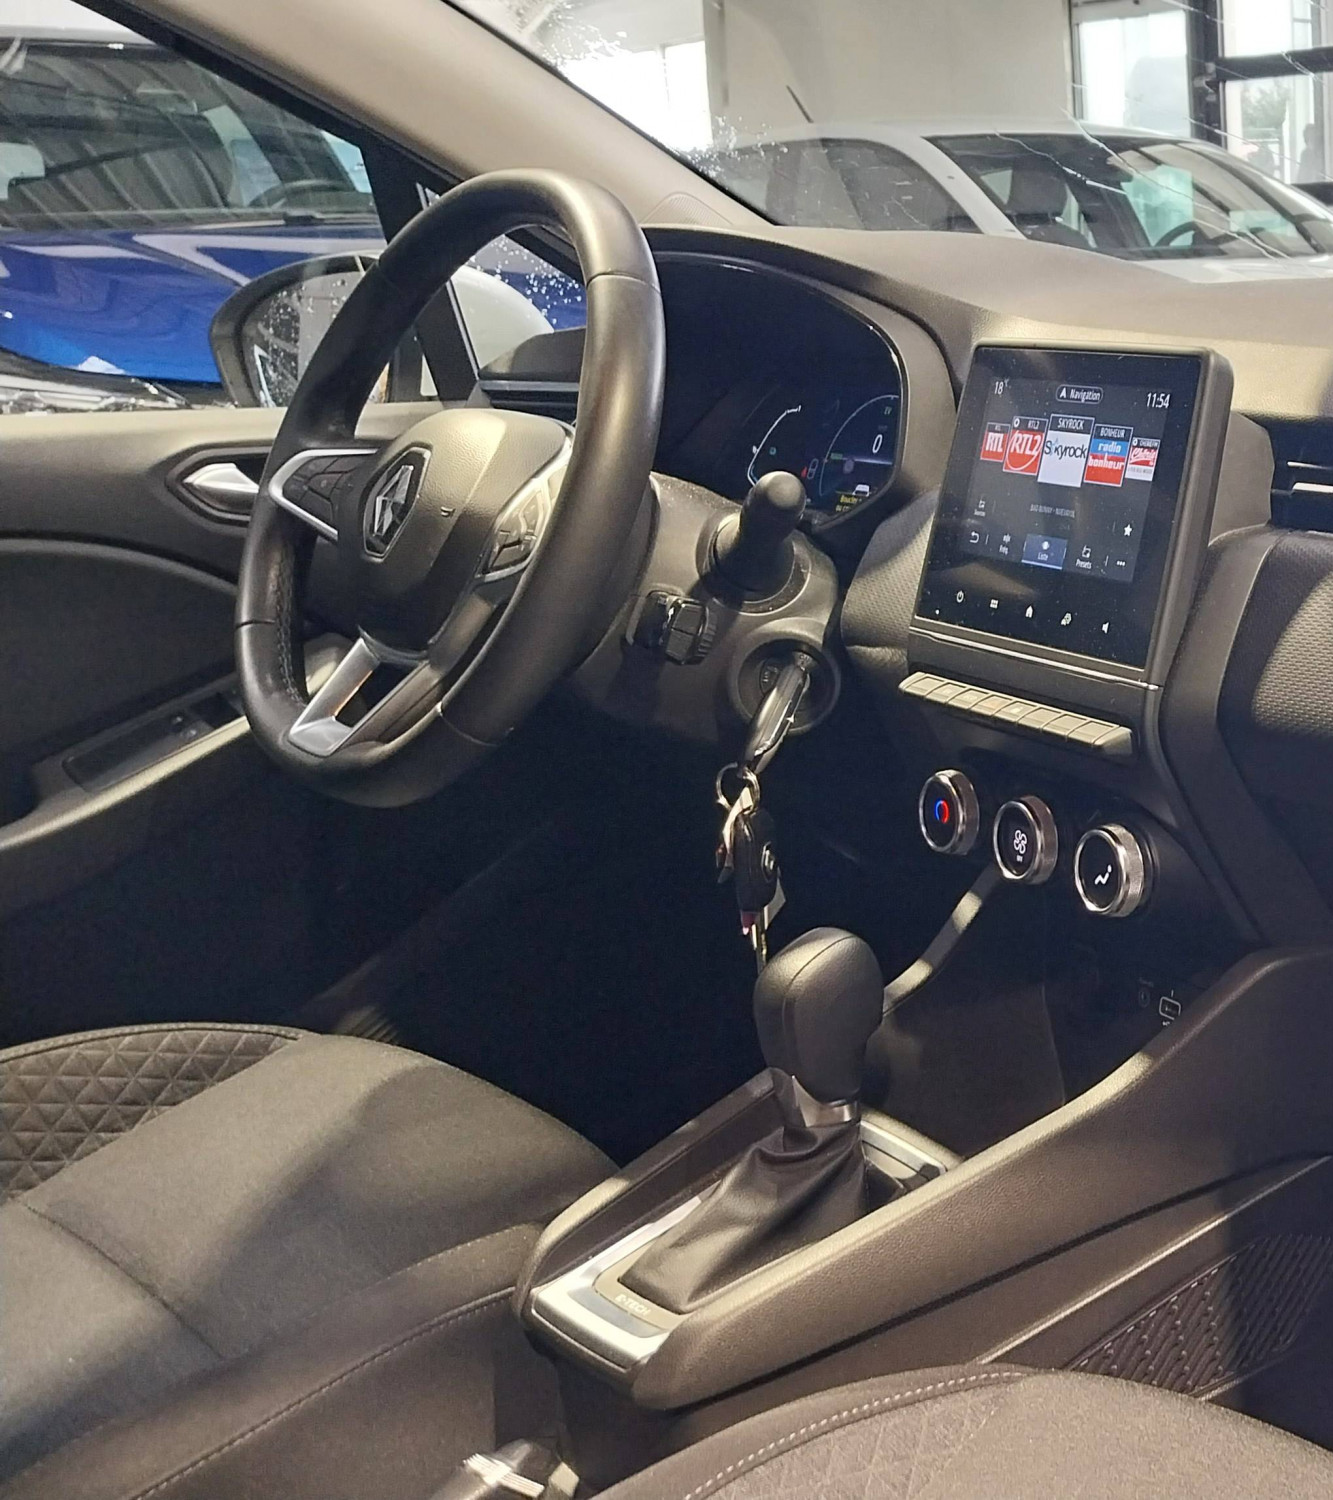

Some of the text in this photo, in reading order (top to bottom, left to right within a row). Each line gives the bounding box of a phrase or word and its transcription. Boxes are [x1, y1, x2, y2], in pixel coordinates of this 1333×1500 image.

[1069, 389, 1101, 402] Navigation
[1146, 392, 1170, 409] 11:54
[1057, 417, 1085, 430] SKYROCK
[1100, 427, 1126, 438] BONHEUR
[872, 434, 883, 453] 0
[985, 432, 1004, 453] RTL
[1009, 432, 1042, 456] RTL2
[1044, 438, 1088, 460] Skyrock
[1097, 441, 1122, 453] radio
[1087, 452, 1125, 470] bonheur
